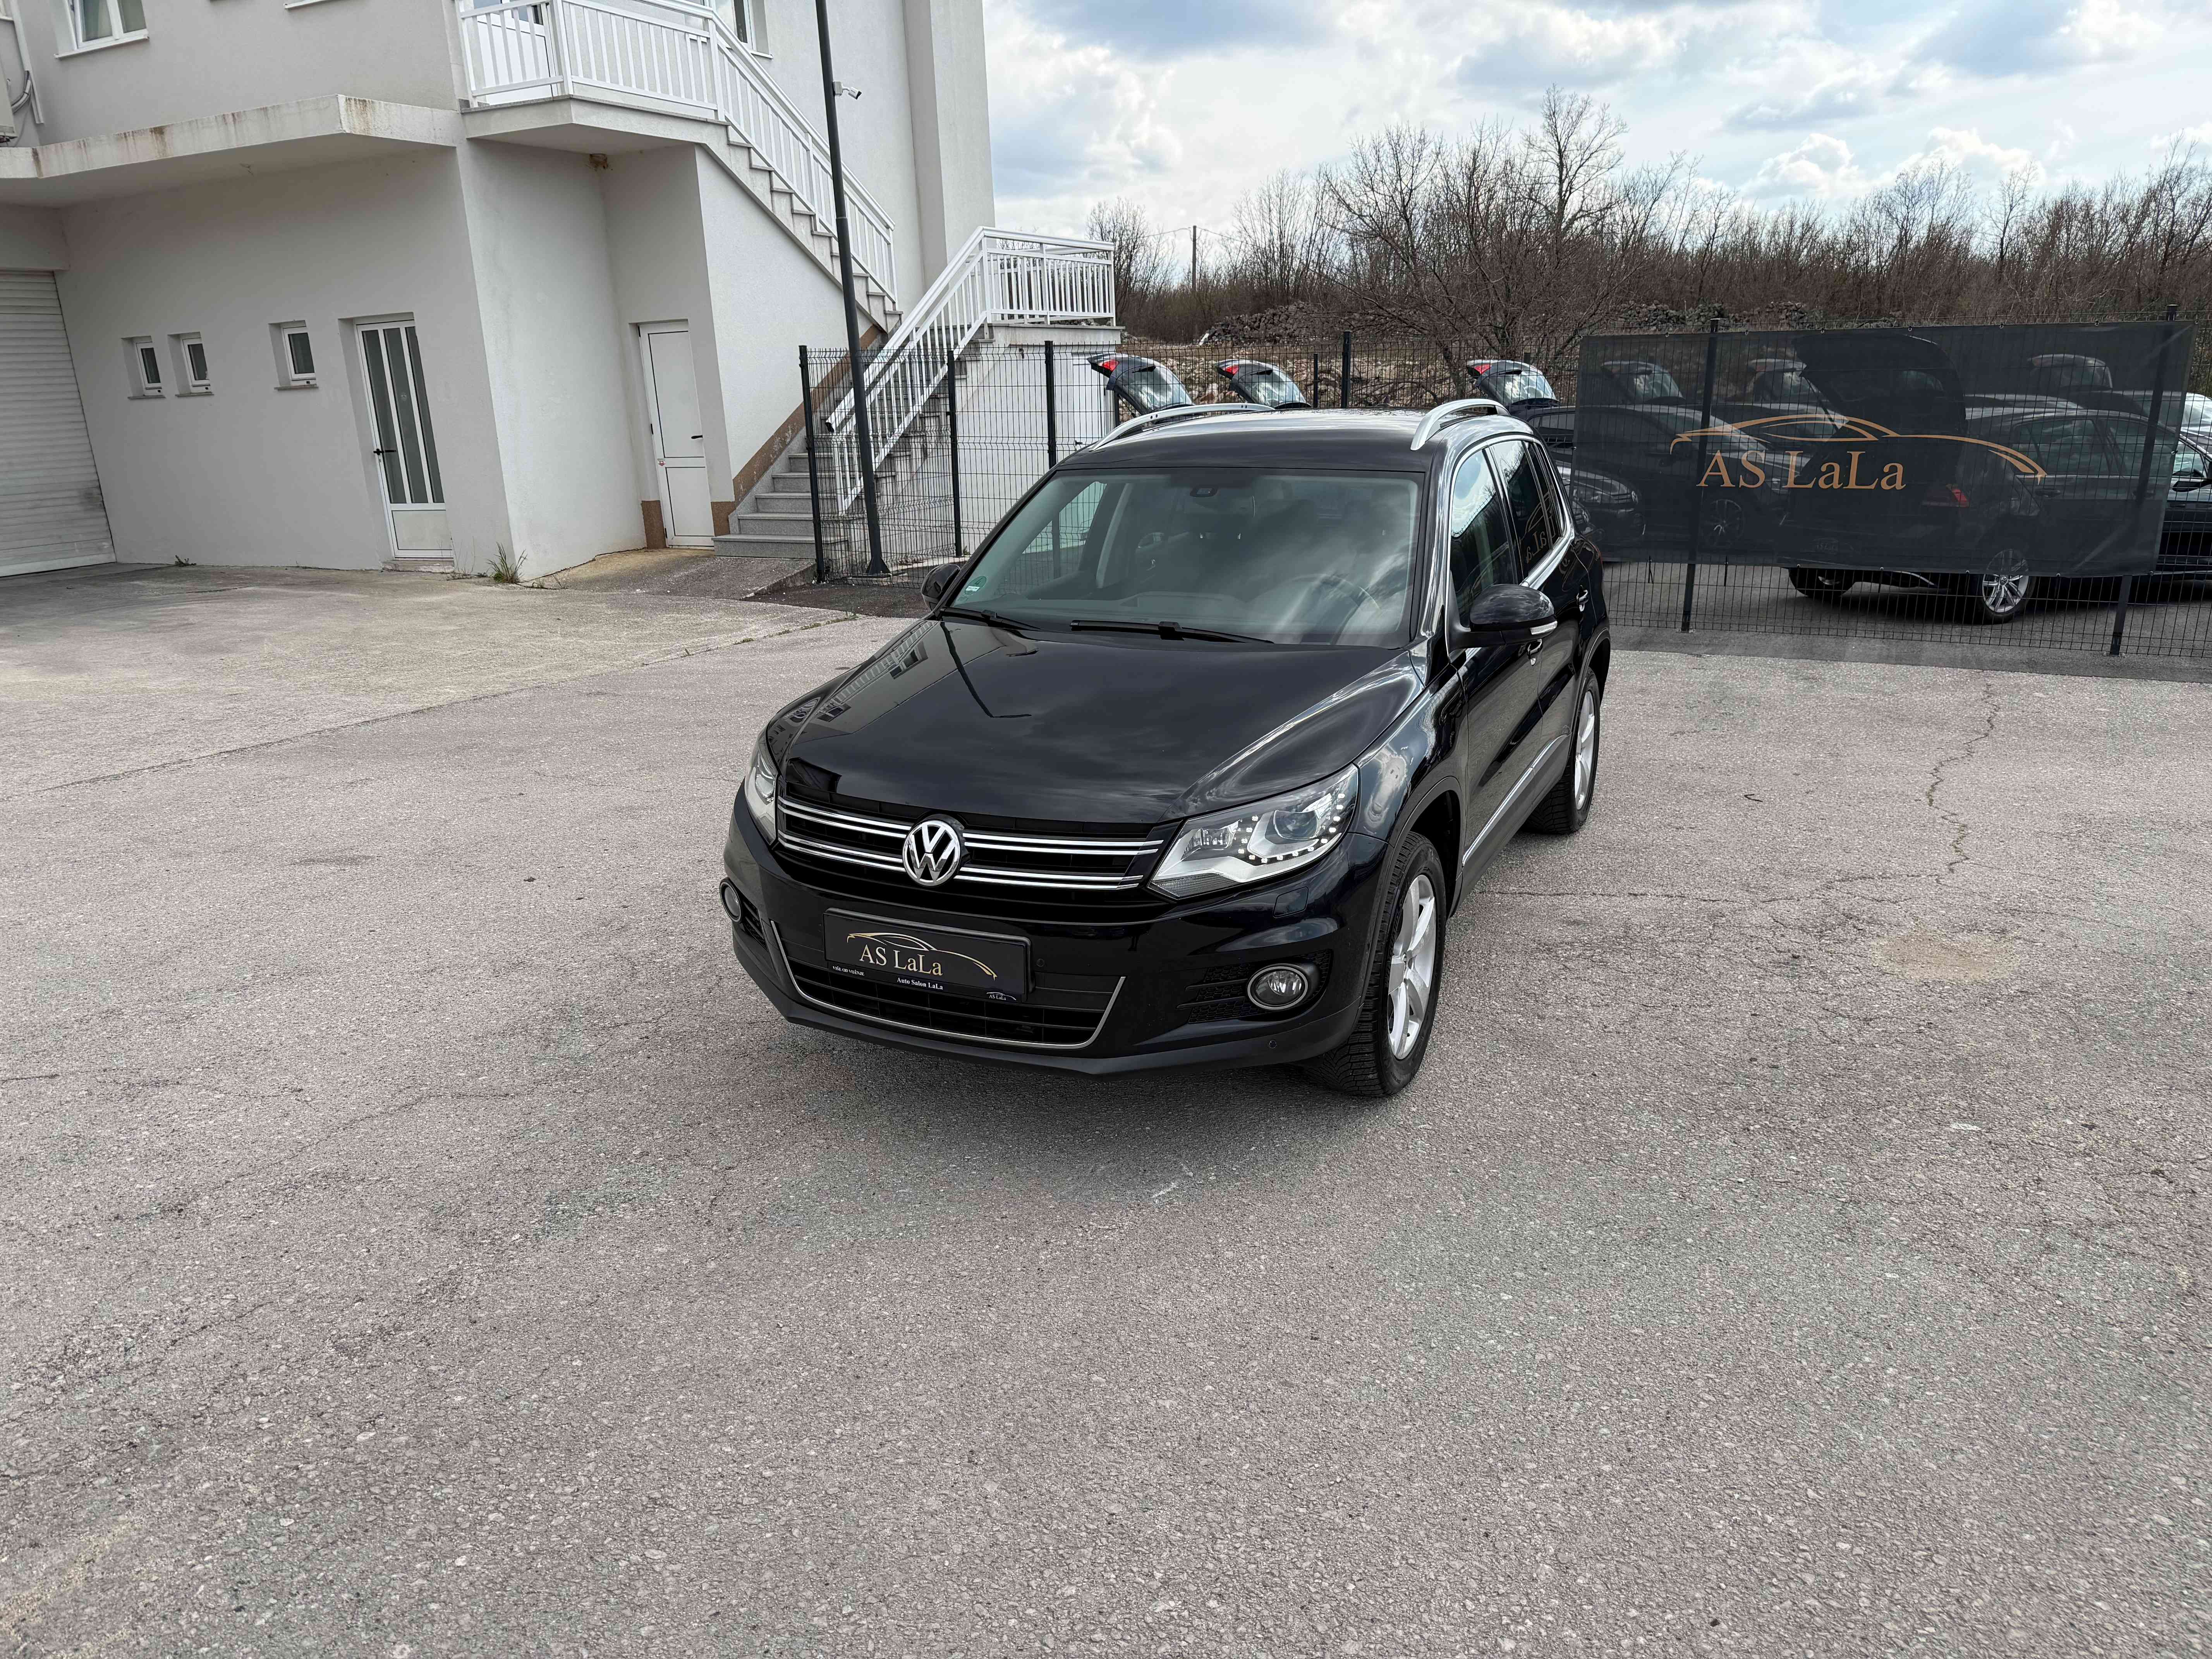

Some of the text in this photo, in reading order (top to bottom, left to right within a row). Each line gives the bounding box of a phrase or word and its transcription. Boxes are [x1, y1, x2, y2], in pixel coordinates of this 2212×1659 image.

[1696, 449, 1906, 490] AS LaLa
[859, 945, 944, 976] AS LaLa
